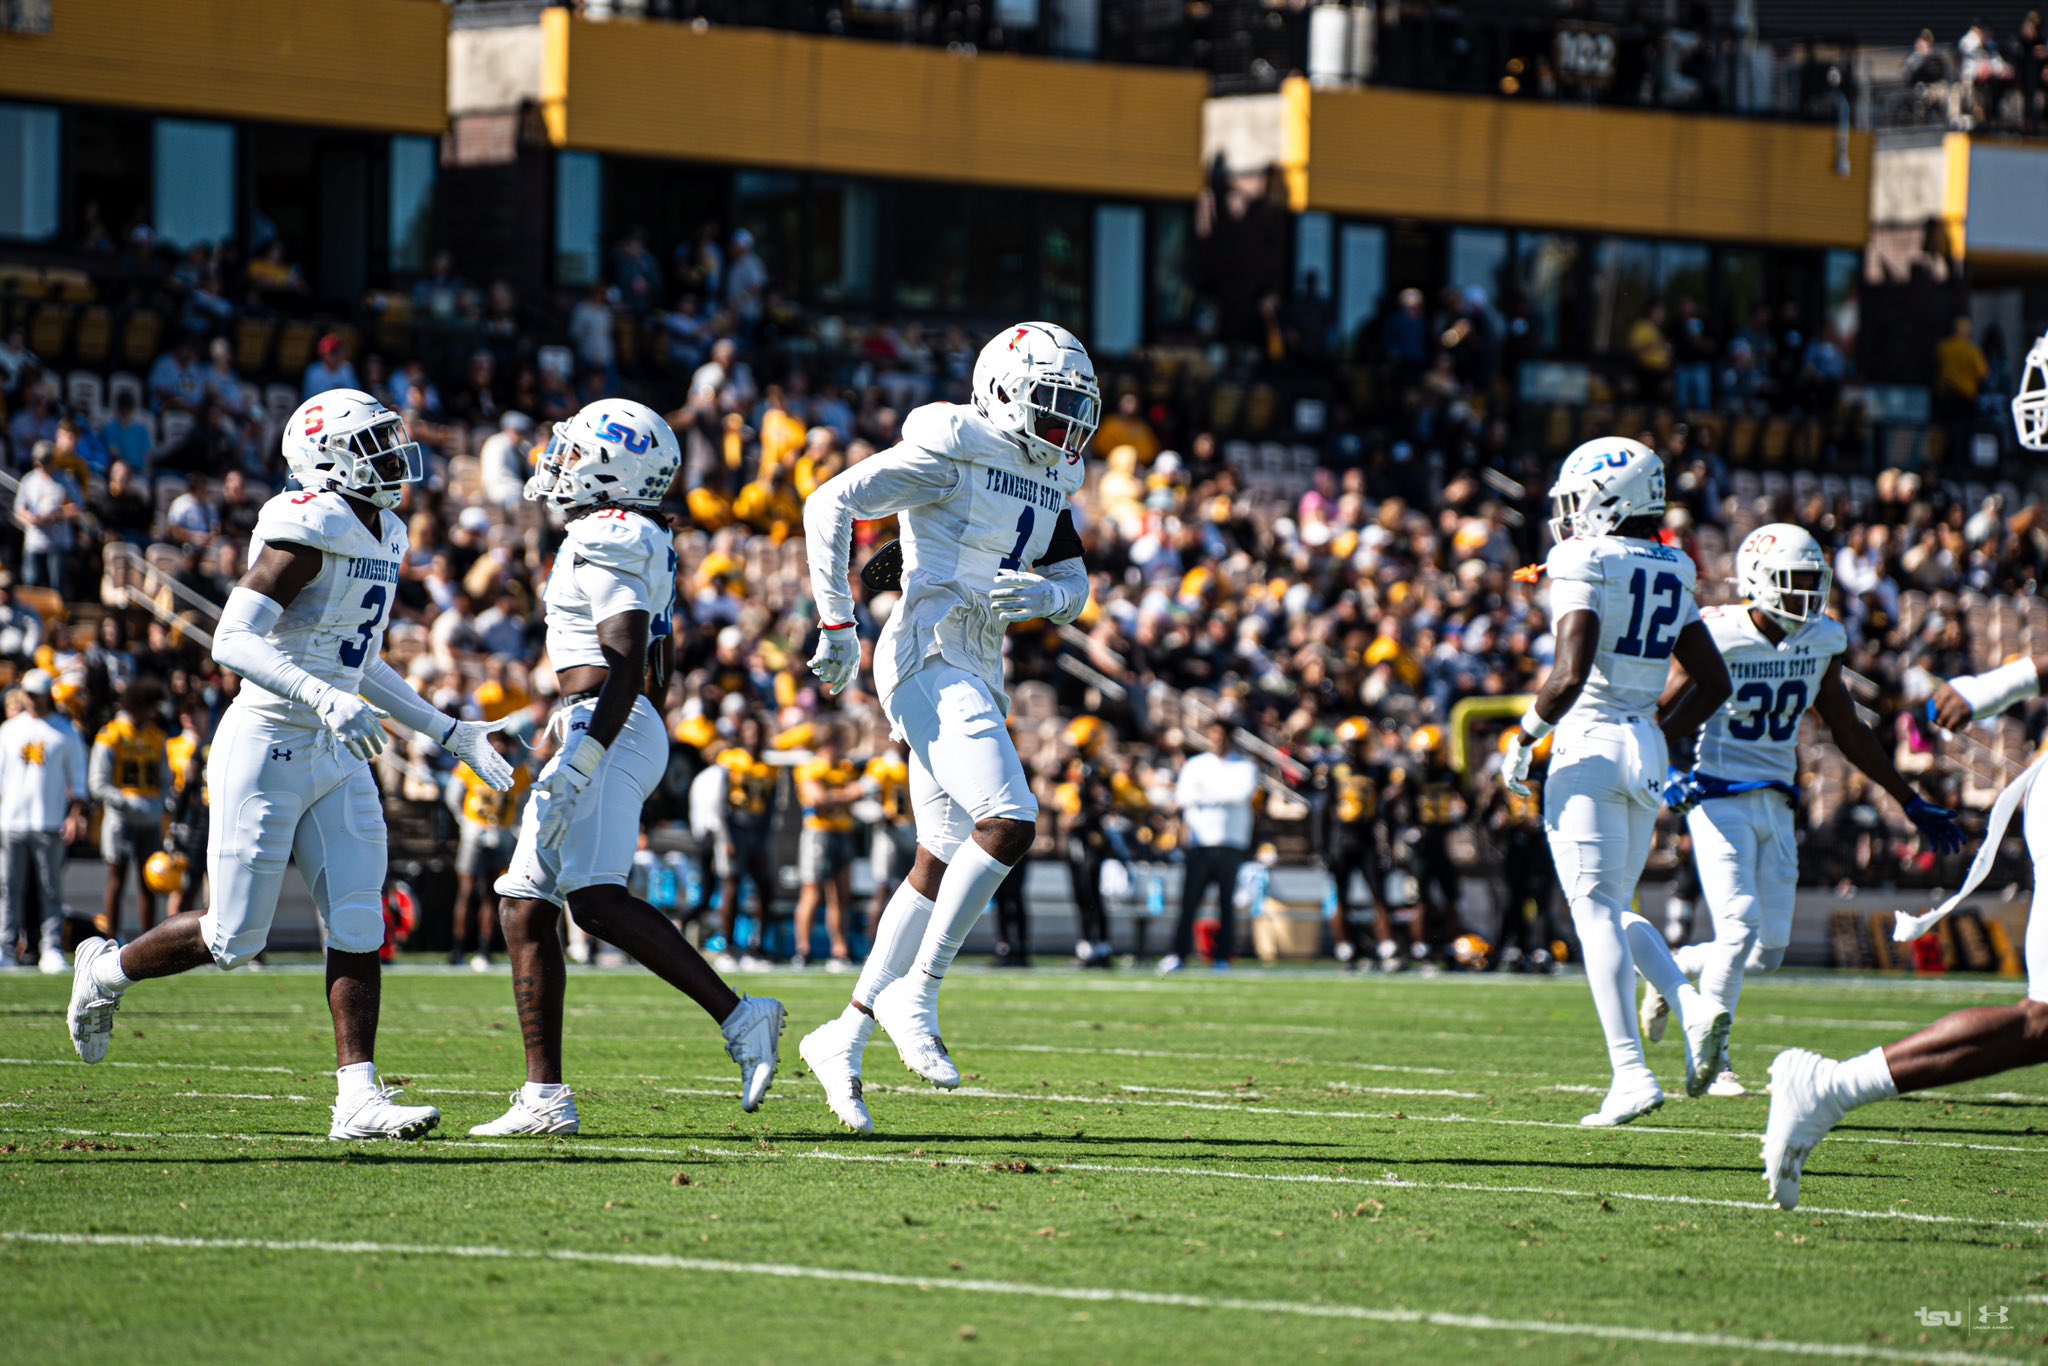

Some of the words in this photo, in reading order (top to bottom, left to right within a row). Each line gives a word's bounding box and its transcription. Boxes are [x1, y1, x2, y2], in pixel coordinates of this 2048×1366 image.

[986, 467, 1038, 504] TENNESSEE
[346, 557, 389, 581] TENNESSEE
[997, 504, 1036, 576] 1
[338, 584, 387, 669] 3
[1613, 568, 1682, 659] 12
[1730, 661, 1785, 679] TENNESSEE
[1789, 657, 1817, 677] STATE
[1728, 680, 1808, 741] 30
